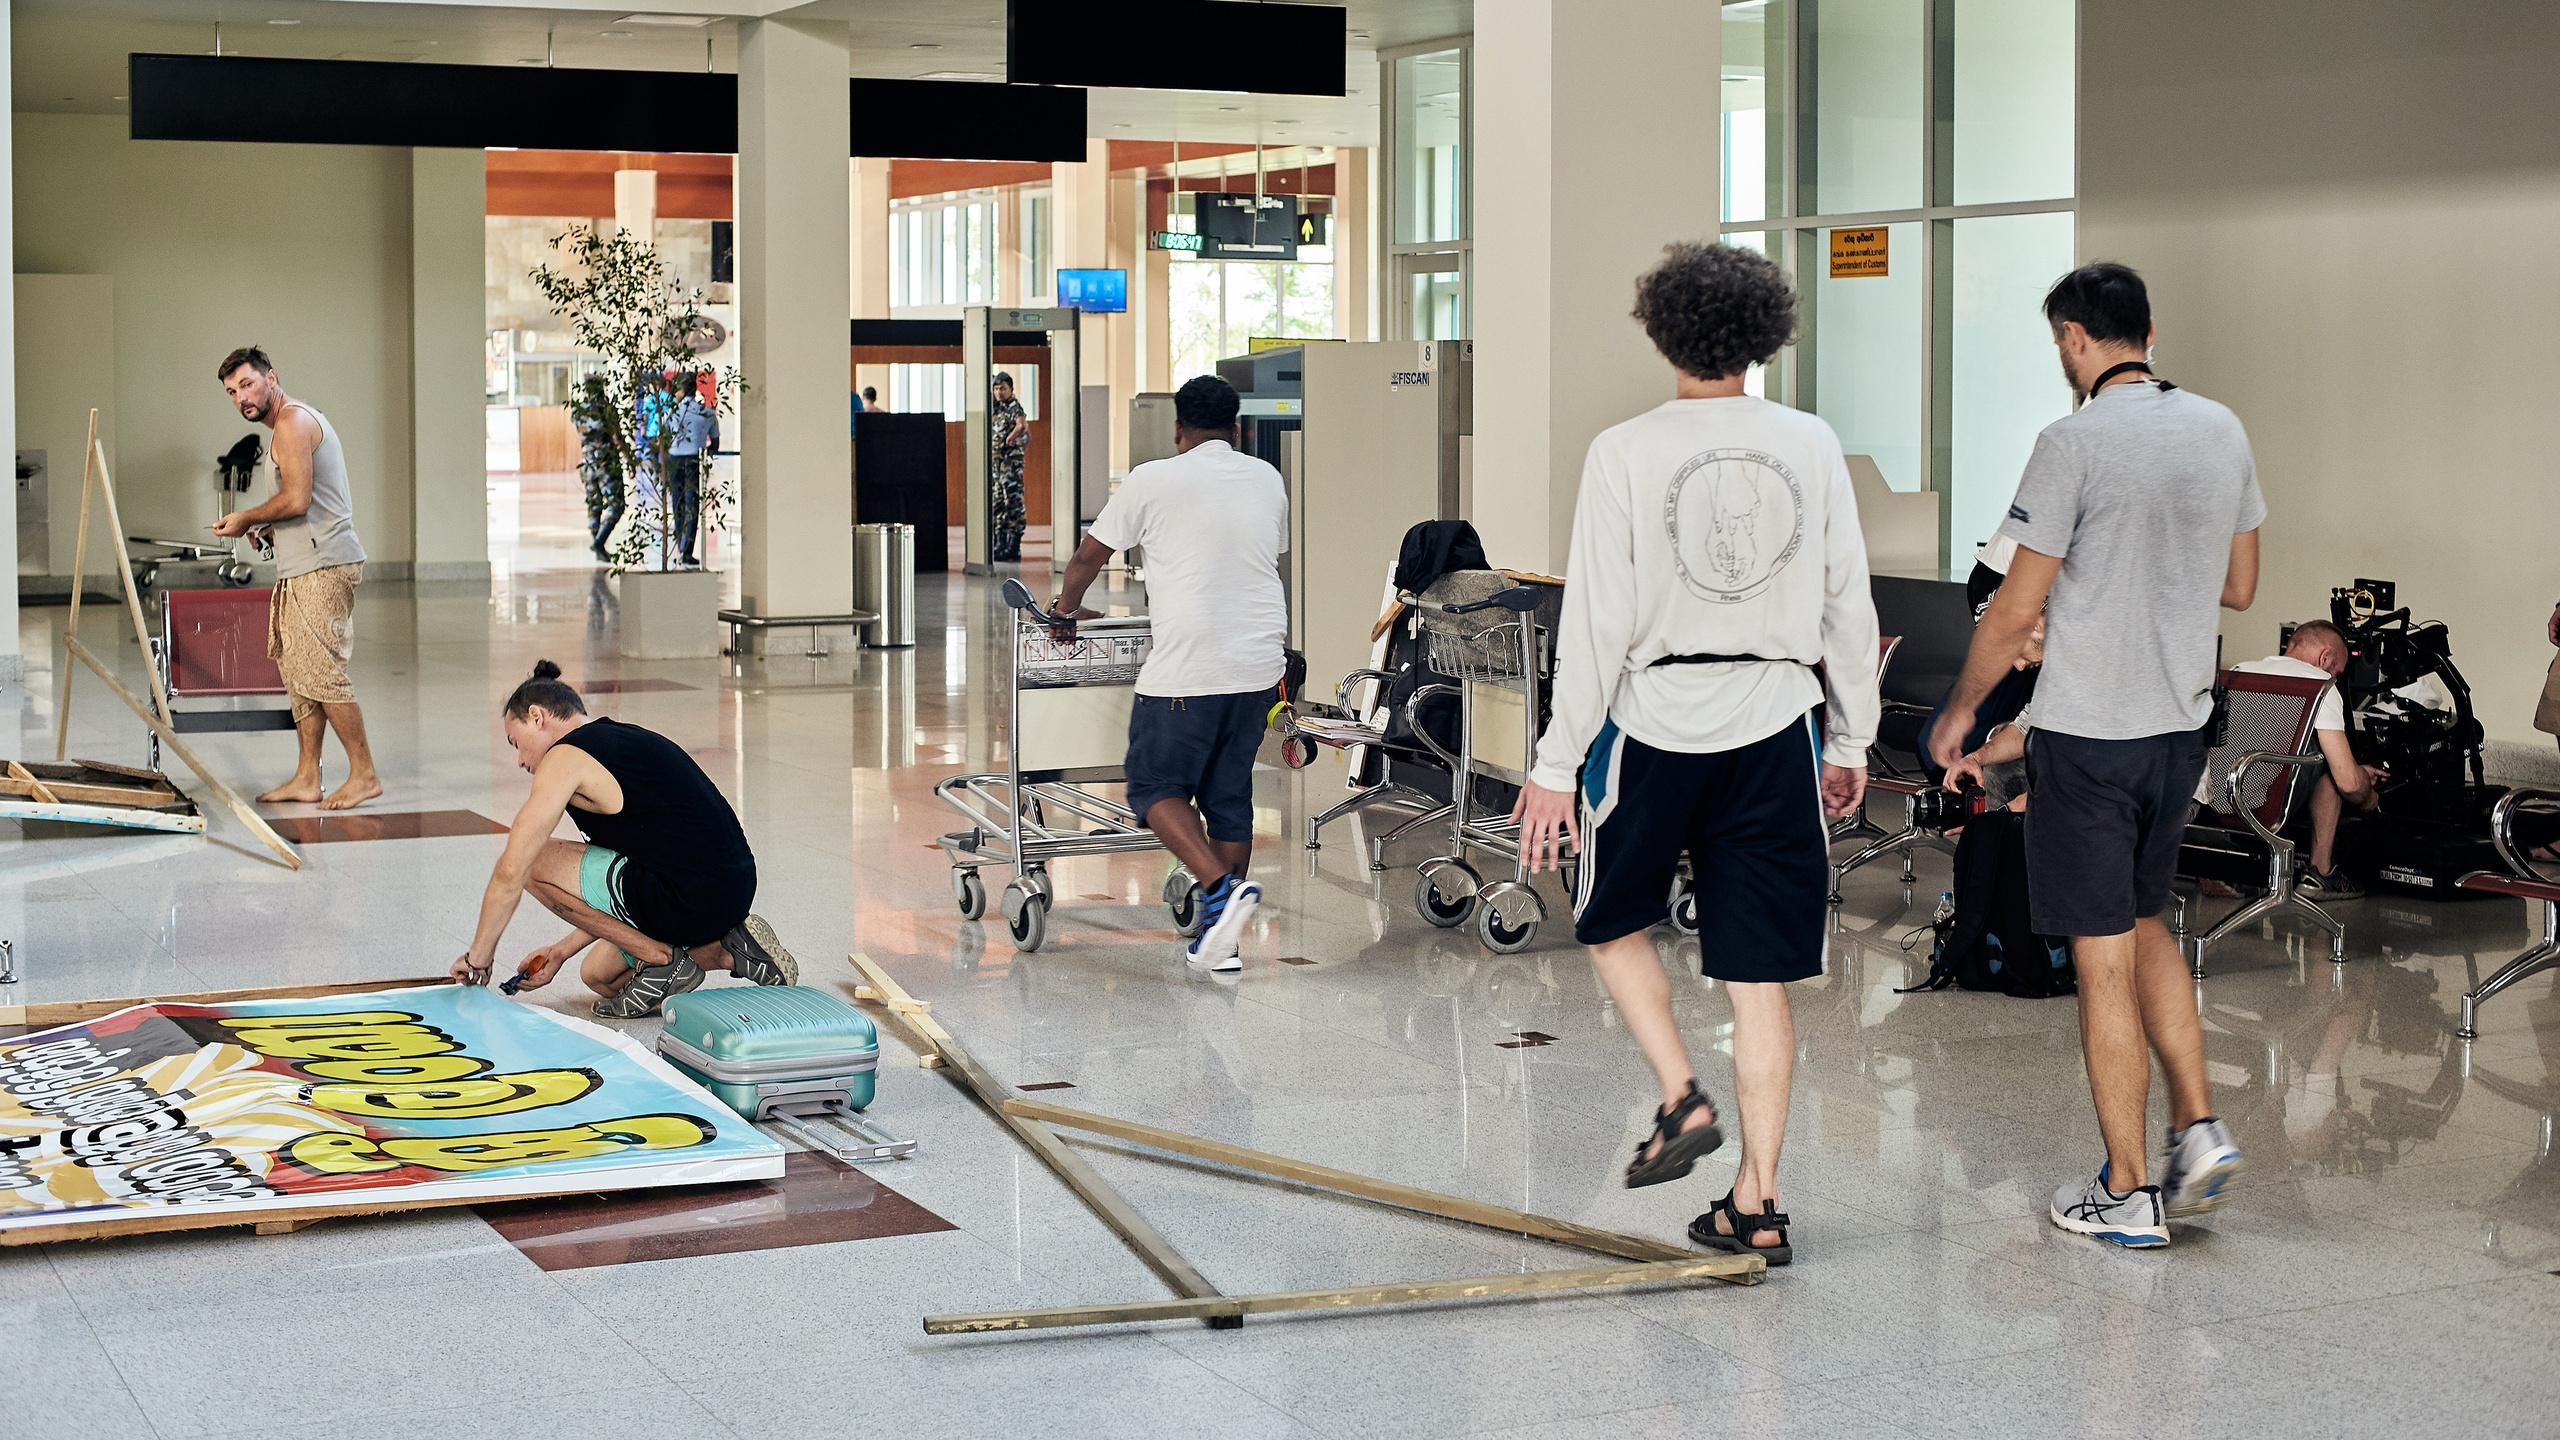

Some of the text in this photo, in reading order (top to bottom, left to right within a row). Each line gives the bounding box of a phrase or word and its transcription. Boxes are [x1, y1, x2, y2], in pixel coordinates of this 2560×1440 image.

[1832, 260, 1862, 271] Superintendent
[1867, 259, 1886, 268] Customs
[1425, 345, 1431, 361] 8
[1466, 344, 1473, 353] 8
[1398, 372, 1429, 386] FISCAN
[1745, 452, 1769, 463] HANG
[1669, 492, 1676, 504] MY
[1667, 506, 1676, 517] TO
